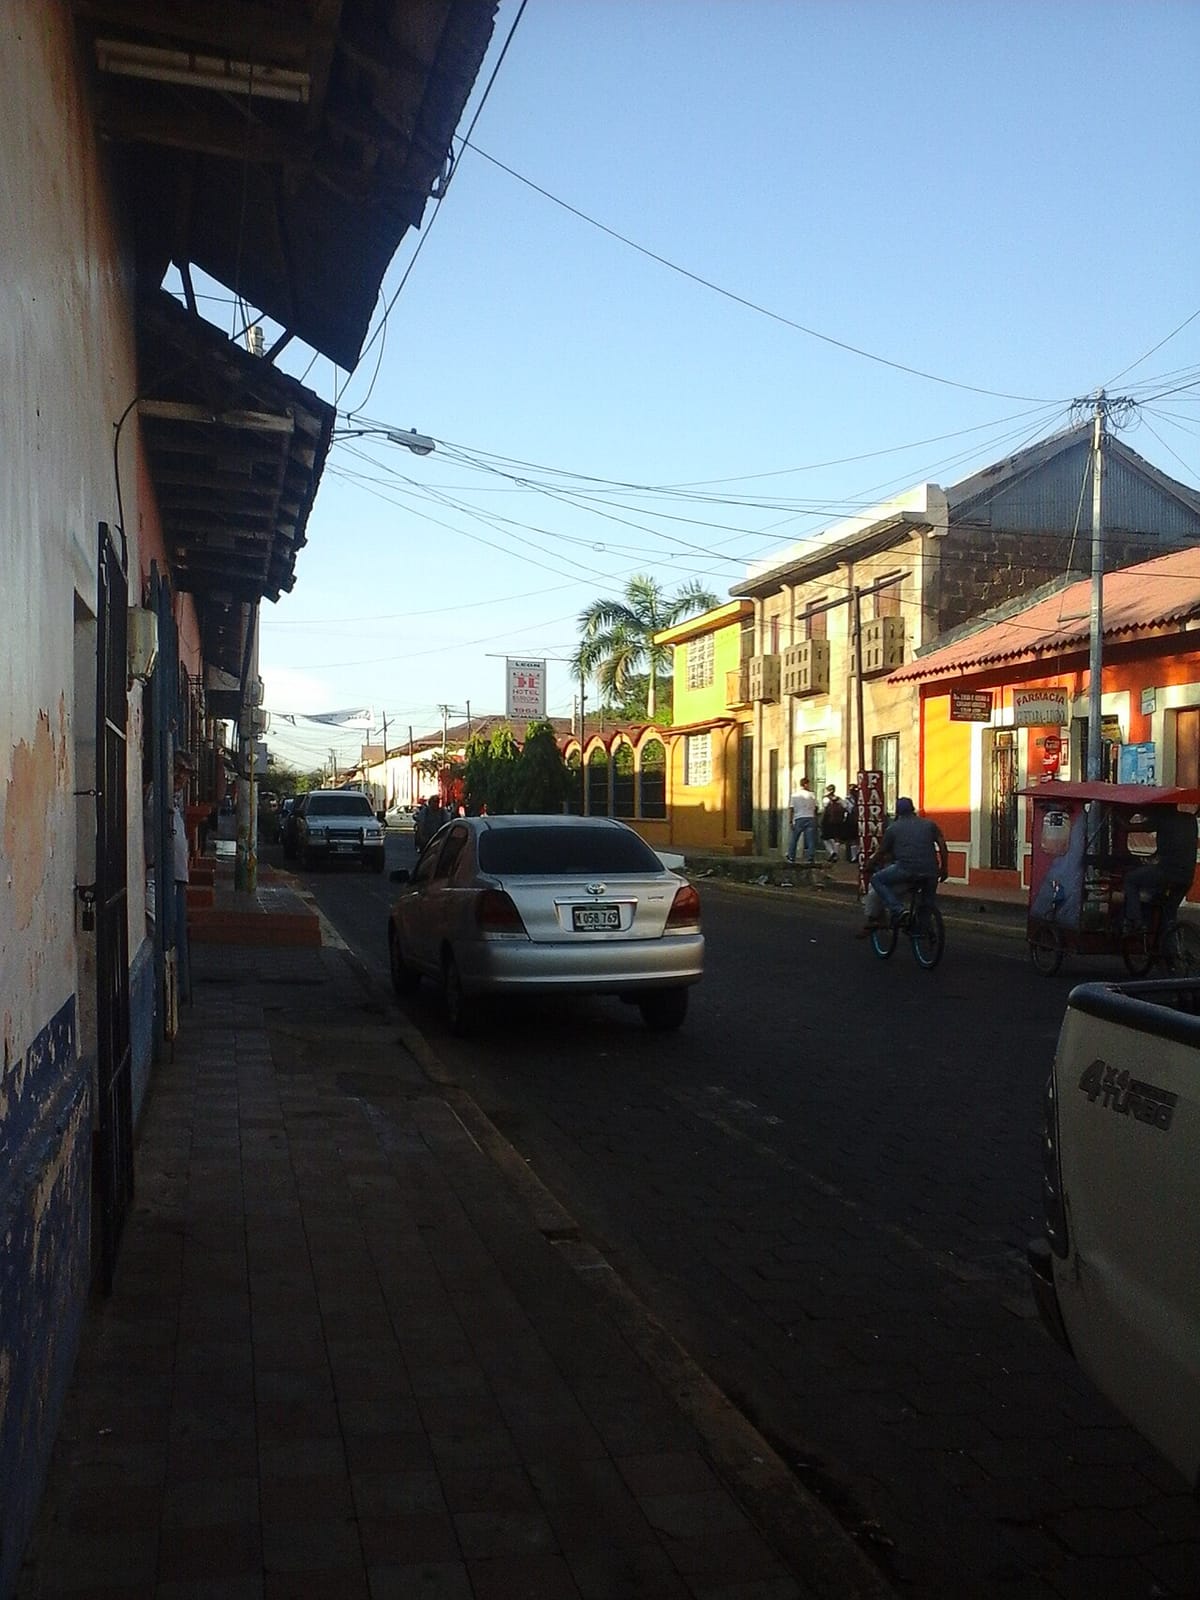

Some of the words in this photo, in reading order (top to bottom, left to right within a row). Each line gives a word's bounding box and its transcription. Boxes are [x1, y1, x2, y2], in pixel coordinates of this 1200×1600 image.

[1016, 692, 1065, 706] FARMACIA
[583, 912, 600, 925] 058
[1101, 1082, 1173, 1132] TURBO
